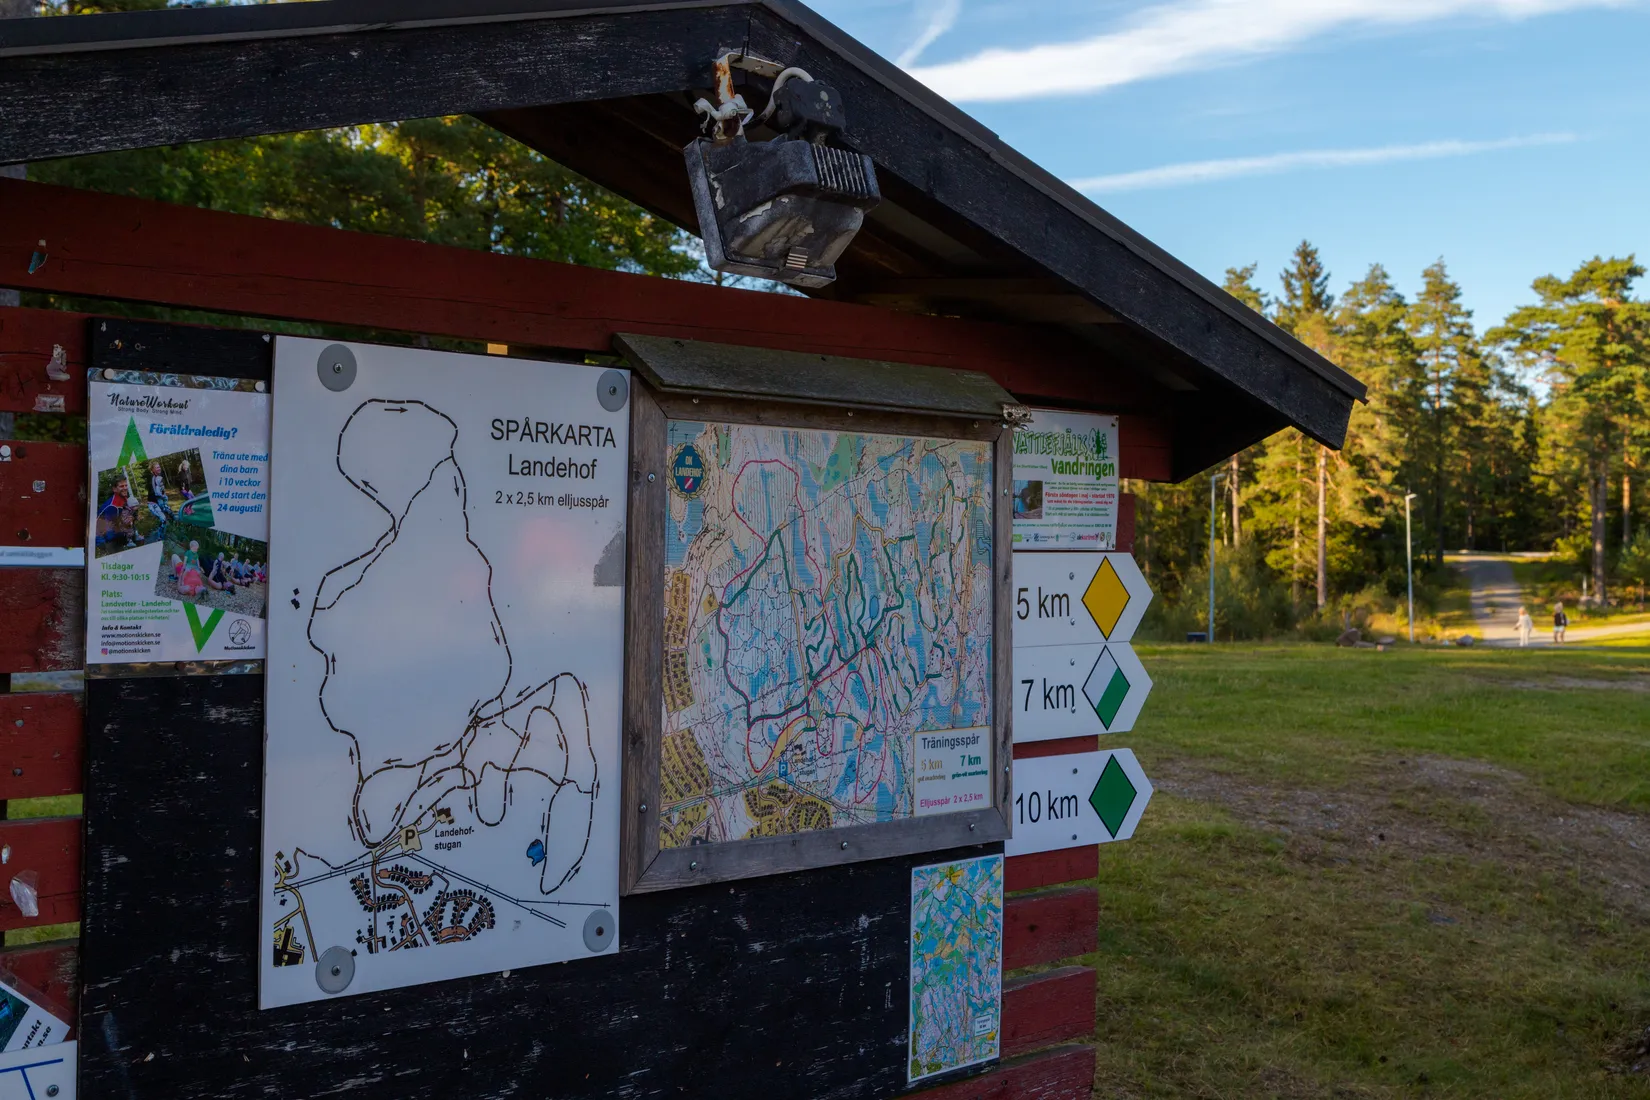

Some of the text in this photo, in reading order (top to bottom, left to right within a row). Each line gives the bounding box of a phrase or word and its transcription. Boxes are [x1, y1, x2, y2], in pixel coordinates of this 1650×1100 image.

[149, 423, 238, 440] Föräldraledig?
[490, 416, 616, 448] SPÅRKARTA
[212, 450, 268, 462] Träna ute med
[220, 464, 258, 474] dina barn
[508, 454, 597, 479] Landehof
[219, 478, 261, 487] i 10 veckor
[212, 490, 266, 500] med start den
[495, 490, 610, 510] 2 x 2,5 km elljusspår
[217, 504, 262, 515] 24 augusti!
[101, 562, 134, 571] Tisdagar
[1016, 586, 1070, 620] 5 km
[1021, 678, 1075, 712] 7 km
[922, 733, 980, 750] Träningsspår
[921, 759, 943, 771] 5 km
[960, 755, 981, 766] 7 km
[920, 797, 950, 808] Elljusspår
[964, 794, 973, 802] 2,5
[1015, 790, 1078, 824] 10 km
[404, 829, 416, 846] P
[434, 826, 475, 838] Landehof-
[434, 840, 462, 851] stugan
